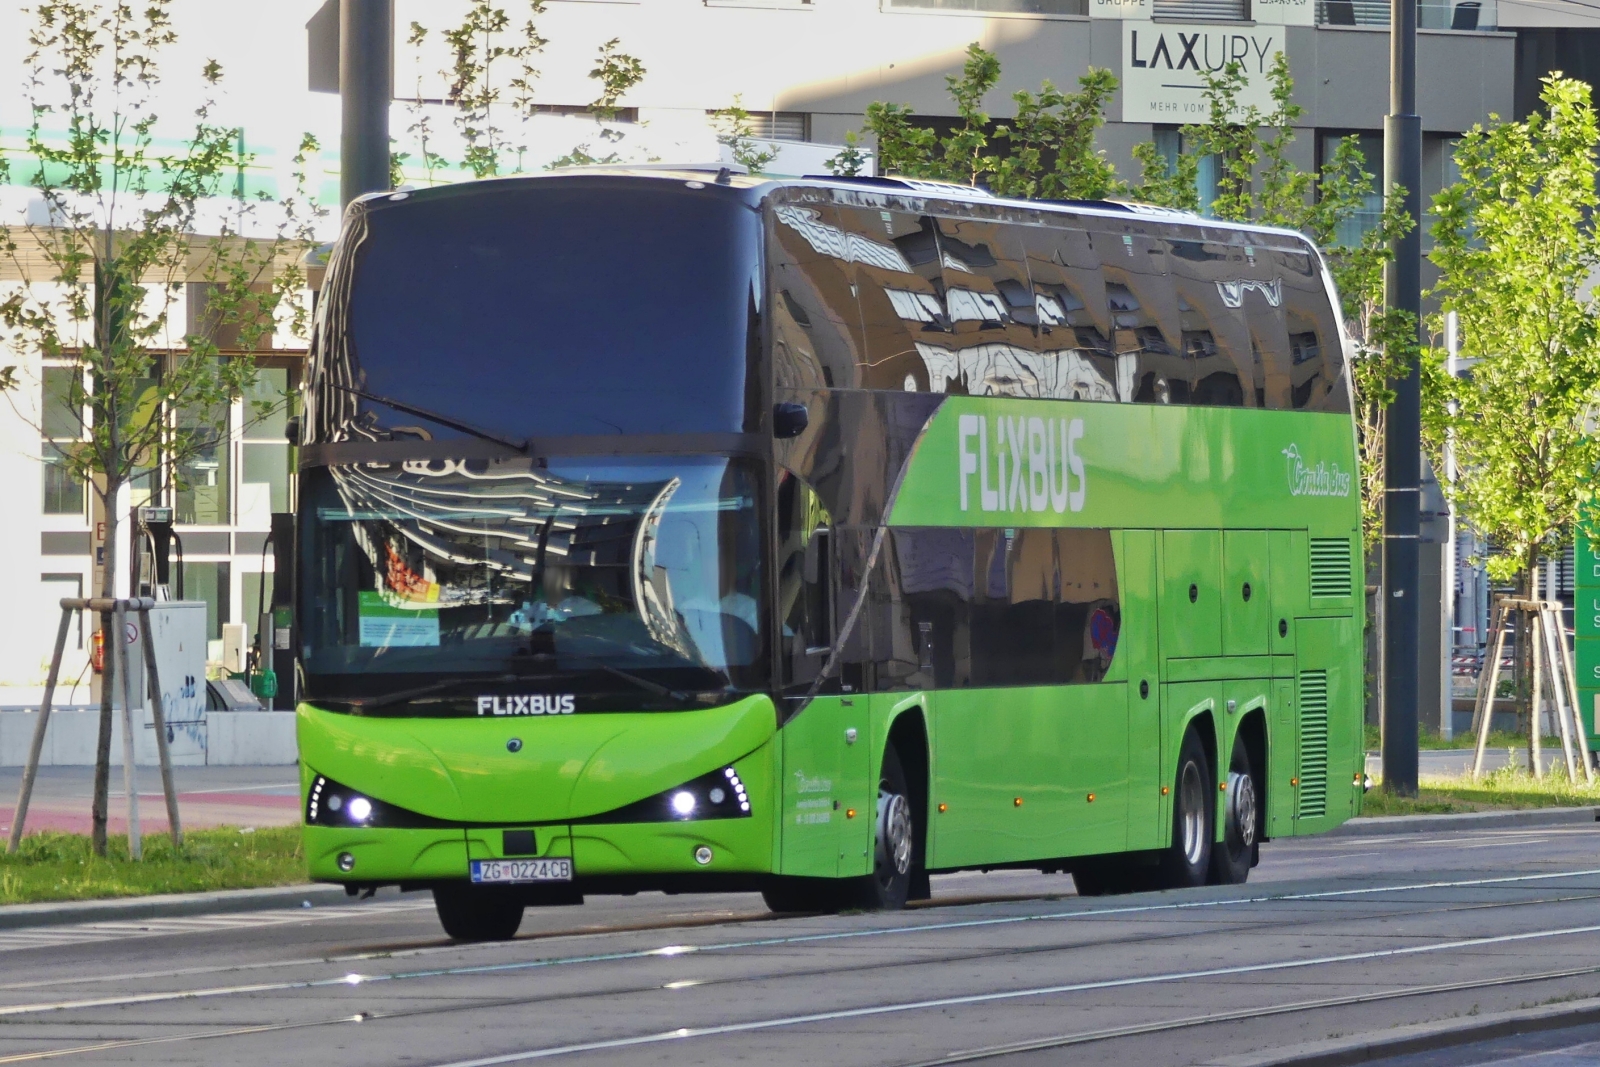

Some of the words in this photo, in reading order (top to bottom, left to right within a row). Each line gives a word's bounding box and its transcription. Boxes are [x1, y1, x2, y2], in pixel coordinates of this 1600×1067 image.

[1131, 30, 1273, 74] LAXURY
[1150, 101, 1178, 112] MEHR
[1183, 103, 1205, 113] VOM
